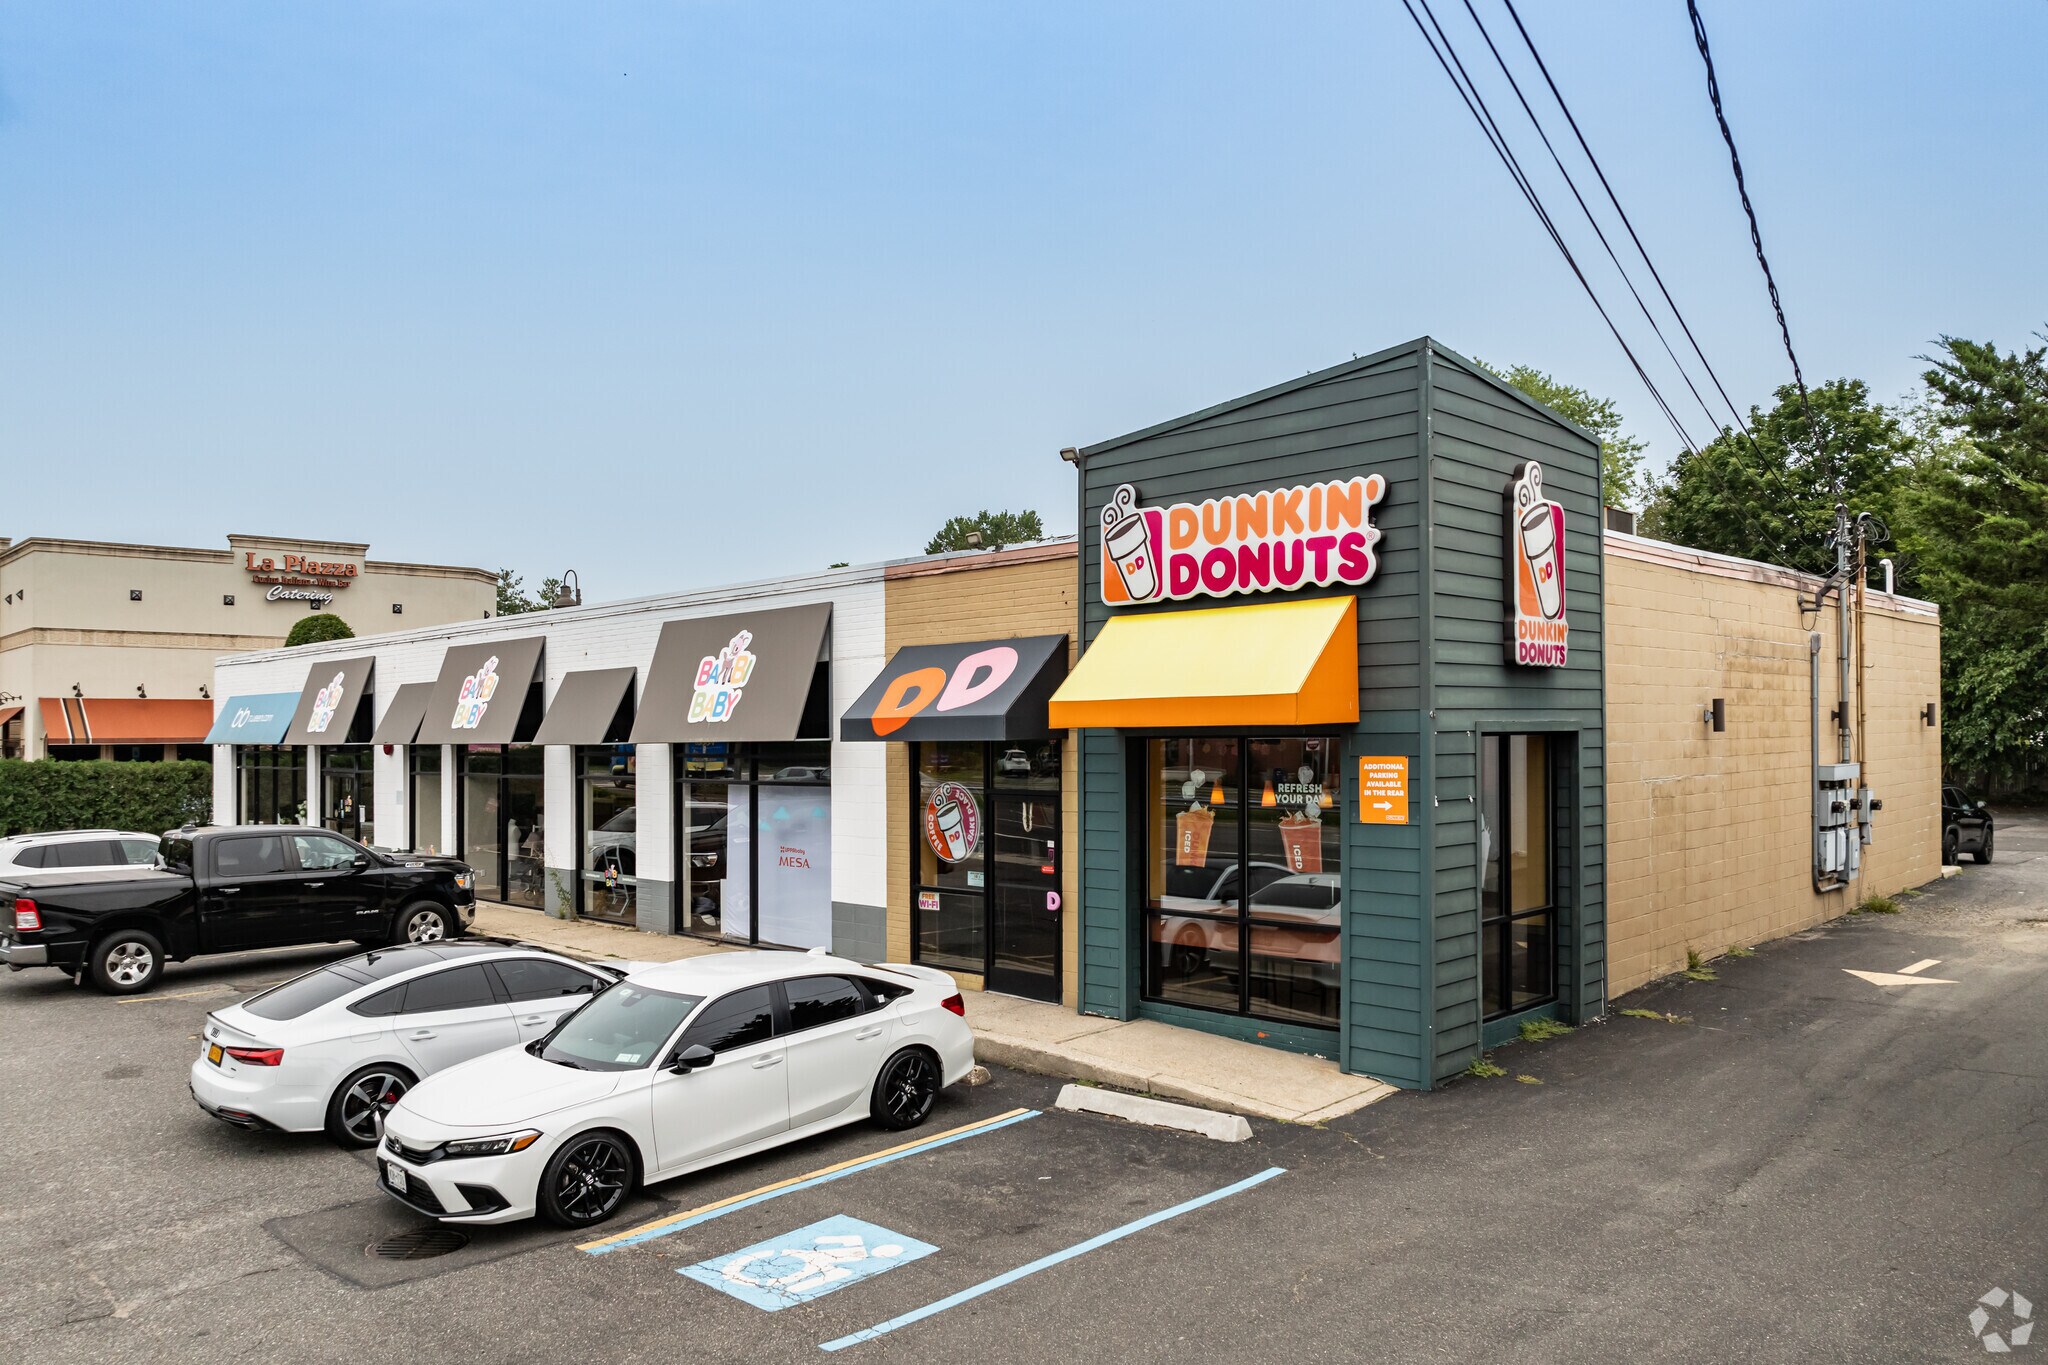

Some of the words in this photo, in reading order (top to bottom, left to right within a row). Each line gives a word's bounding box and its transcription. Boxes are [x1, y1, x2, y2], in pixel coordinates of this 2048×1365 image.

[1169, 479, 1379, 550] DUNKIN'
[246, 552, 275, 572] La
[284, 555, 358, 577] Piazza
[1125, 556, 1145, 576] DD
[1169, 531, 1369, 596] DONUTS
[1538, 561, 1553, 584] DD
[266, 585, 333, 605] Catering
[338, 579, 351, 588] Bar
[1518, 619, 1568, 643] DUNKIN'
[1519, 641, 1566, 665] DONUTS
[871, 646, 1019, 737] DD
[454, 703, 486, 726] BABY
[690, 690, 740, 719] BABY
[309, 711, 333, 730] BABY
[1275, 794, 1304, 804] YOUR
[1278, 783, 1322, 793] REFRESH
[955, 789, 974, 815] PLACE
[928, 814, 943, 851] COFFEE
[967, 816, 976, 842] BAKE
[779, 856, 811, 868] MESA
[1293, 845, 1303, 870] ICED
[919, 900, 939, 909] WI-FI
